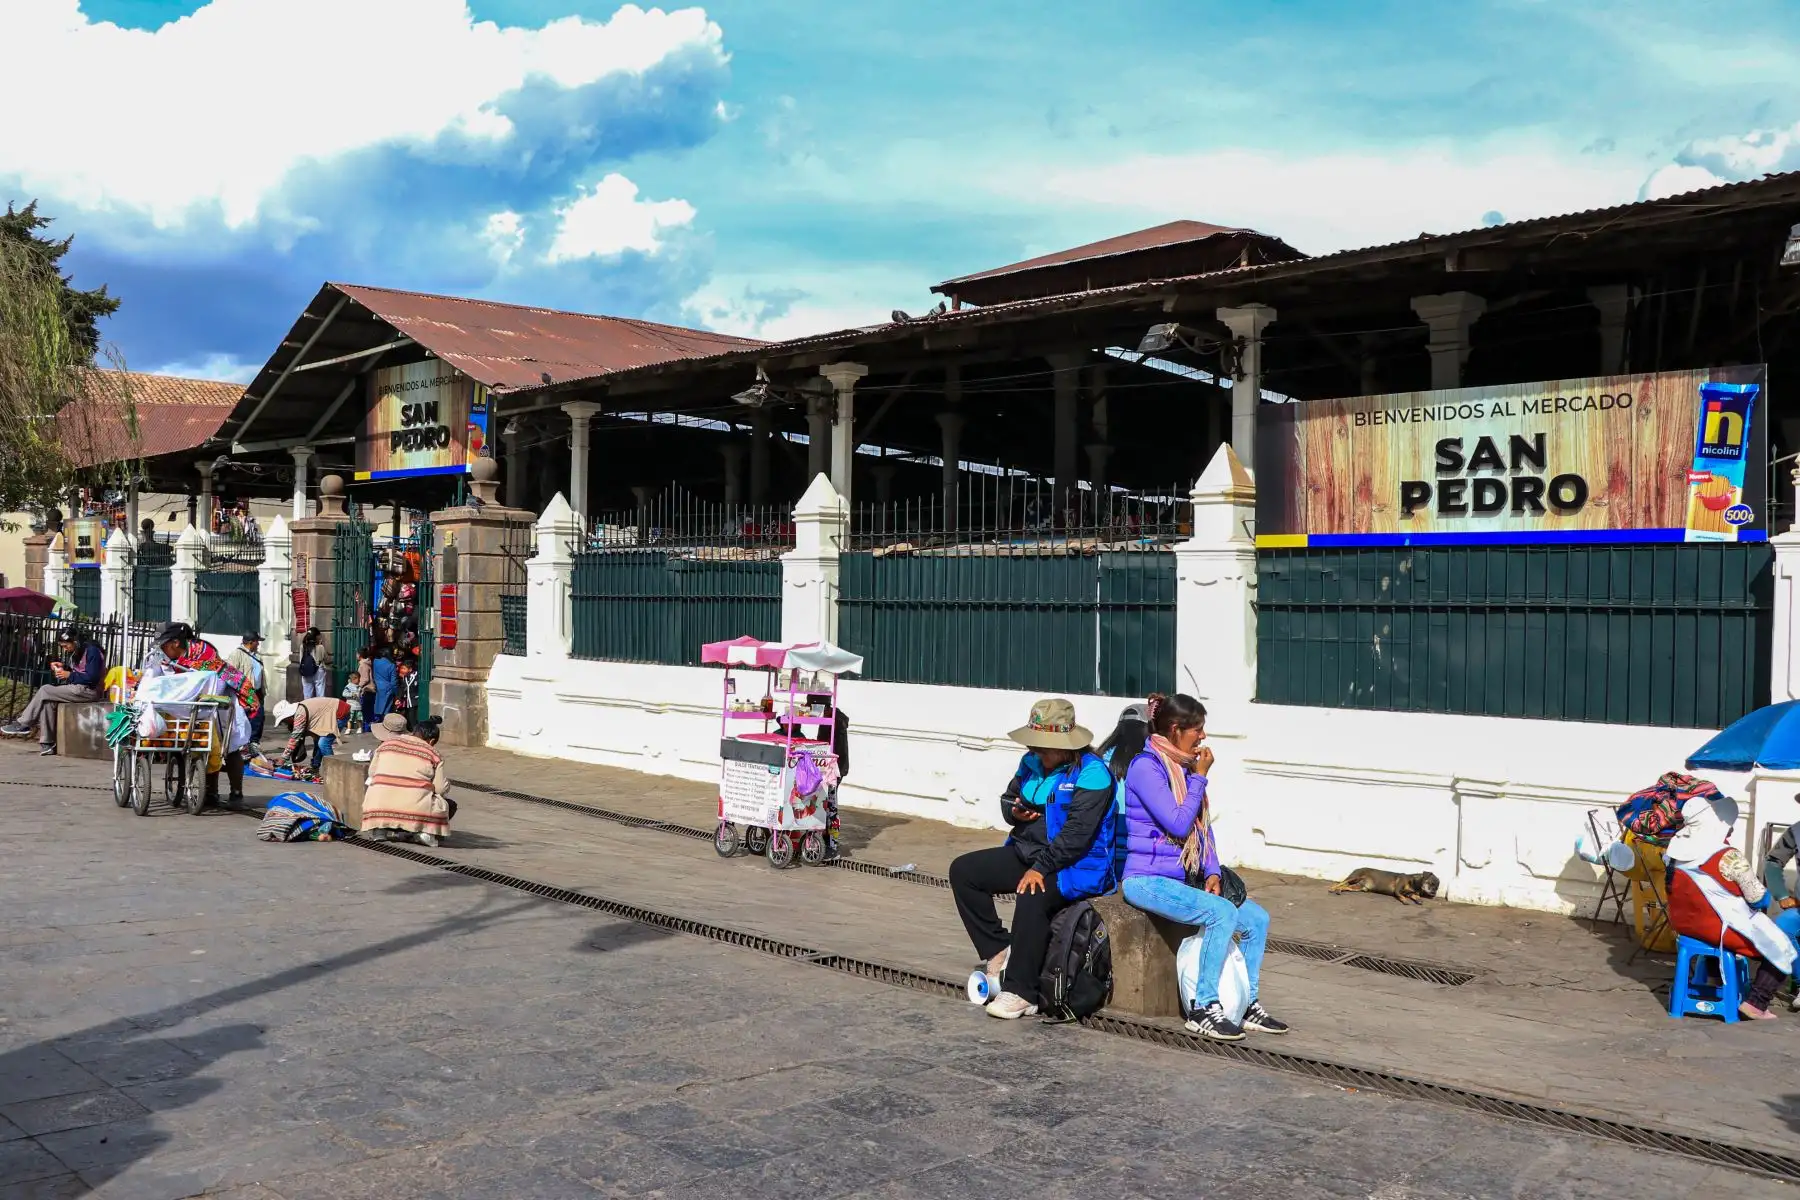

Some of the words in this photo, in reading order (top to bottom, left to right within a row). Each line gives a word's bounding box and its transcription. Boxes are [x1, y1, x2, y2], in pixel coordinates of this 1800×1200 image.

[378, 381, 420, 396] BIENVENIDOS
[420, 380, 429, 389] AL
[401, 401, 439, 427] SAN
[1354, 403, 1485, 426] BIENVENIDOS
[1490, 401, 1516, 418] AL
[1522, 393, 1633, 416] MERCADO
[390, 425, 451, 453] PEDRO
[1702, 446, 1739, 456] nicolini
[1435, 432, 1548, 476] SAN
[1400, 473, 1589, 517] PEDRO
